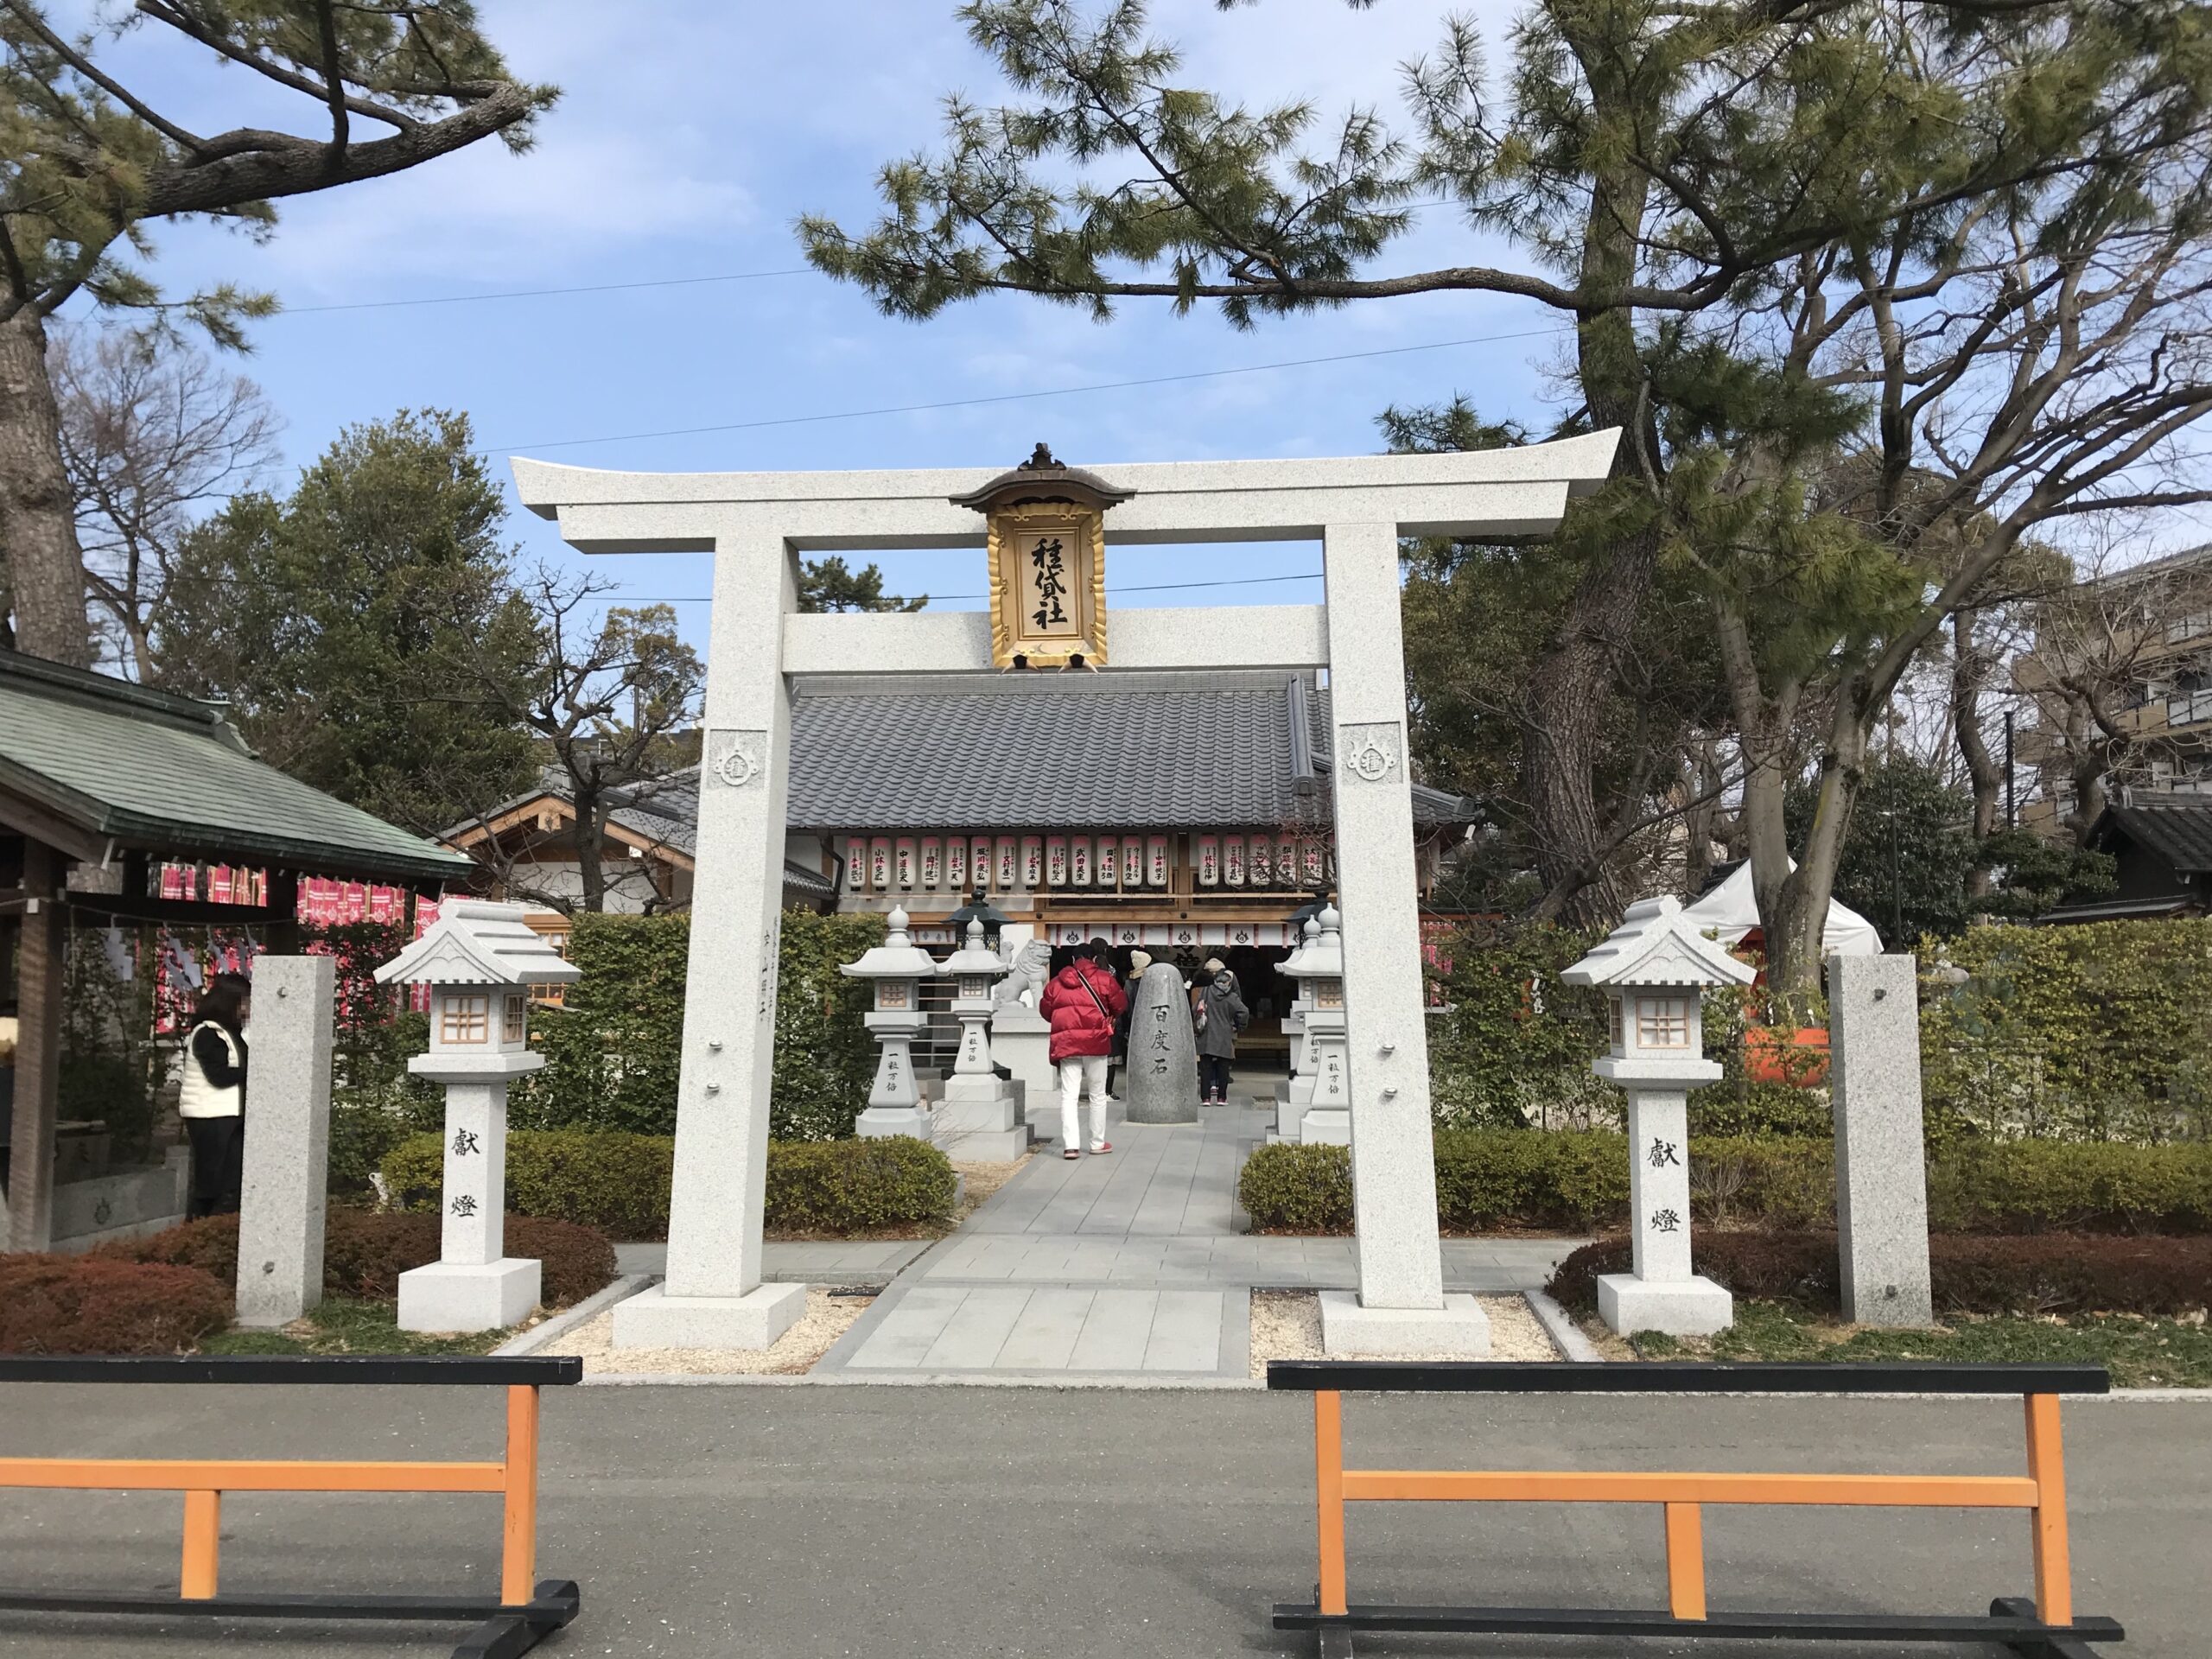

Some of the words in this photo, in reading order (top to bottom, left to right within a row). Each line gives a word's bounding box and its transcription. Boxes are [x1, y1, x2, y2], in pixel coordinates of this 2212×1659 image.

[1032, 537, 1068, 630] 種貸社
[968, 1031, 978, 1063] 一粒万倍
[1150, 1004, 1171, 1075] 百度石
[1310, 1036, 1319, 1064] 粒万倍
[885, 1052, 899, 1092] 一粒万倍
[1327, 1054, 1340, 1095] 一粒万倍
